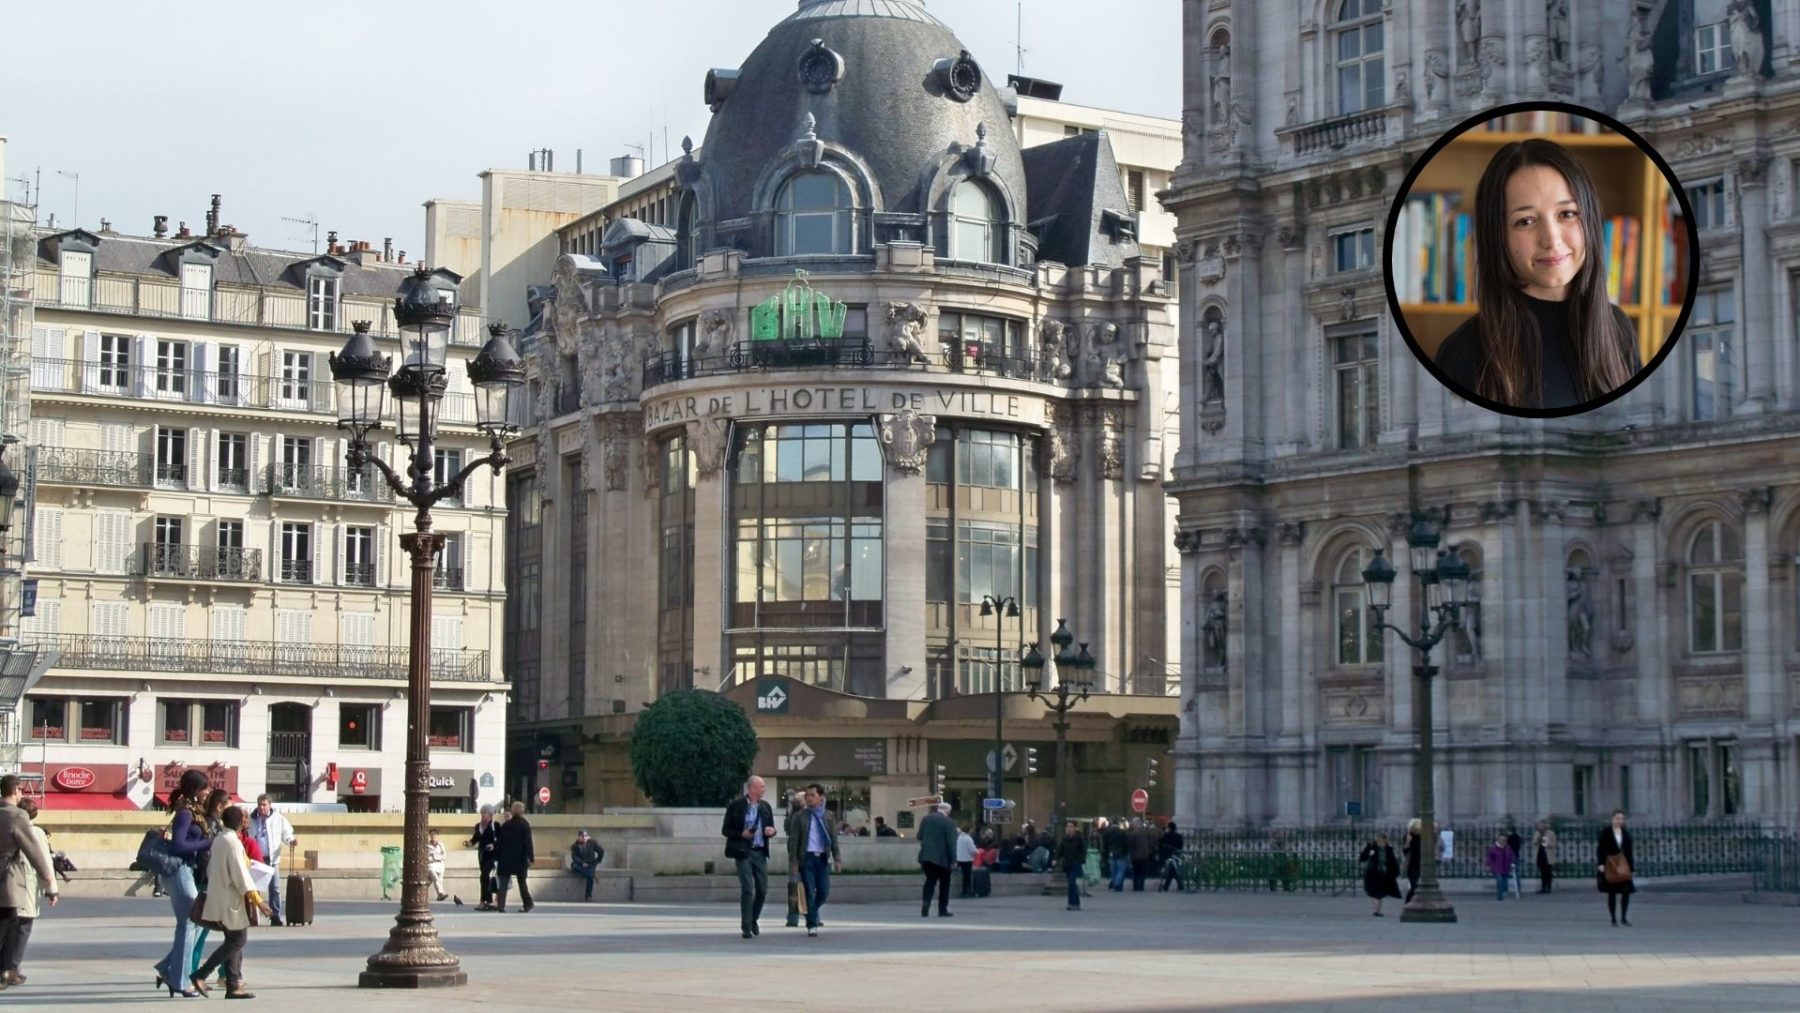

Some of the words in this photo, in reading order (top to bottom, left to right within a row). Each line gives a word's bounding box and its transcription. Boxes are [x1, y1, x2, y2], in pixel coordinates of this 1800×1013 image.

[752, 285, 847, 341] BHV
[648, 397, 697, 427] BAZAR
[708, 396, 732, 416] DE
[746, 388, 876, 412] L'HOTEL
[892, 393, 925, 410] DE
[937, 391, 1019, 417] VILLE
[757, 696, 787, 709] BHV
[777, 754, 816, 770] BHV
[63, 770, 90, 779] Brioche
[356, 771, 366, 784] Q
[428, 776, 455, 787] Quick
